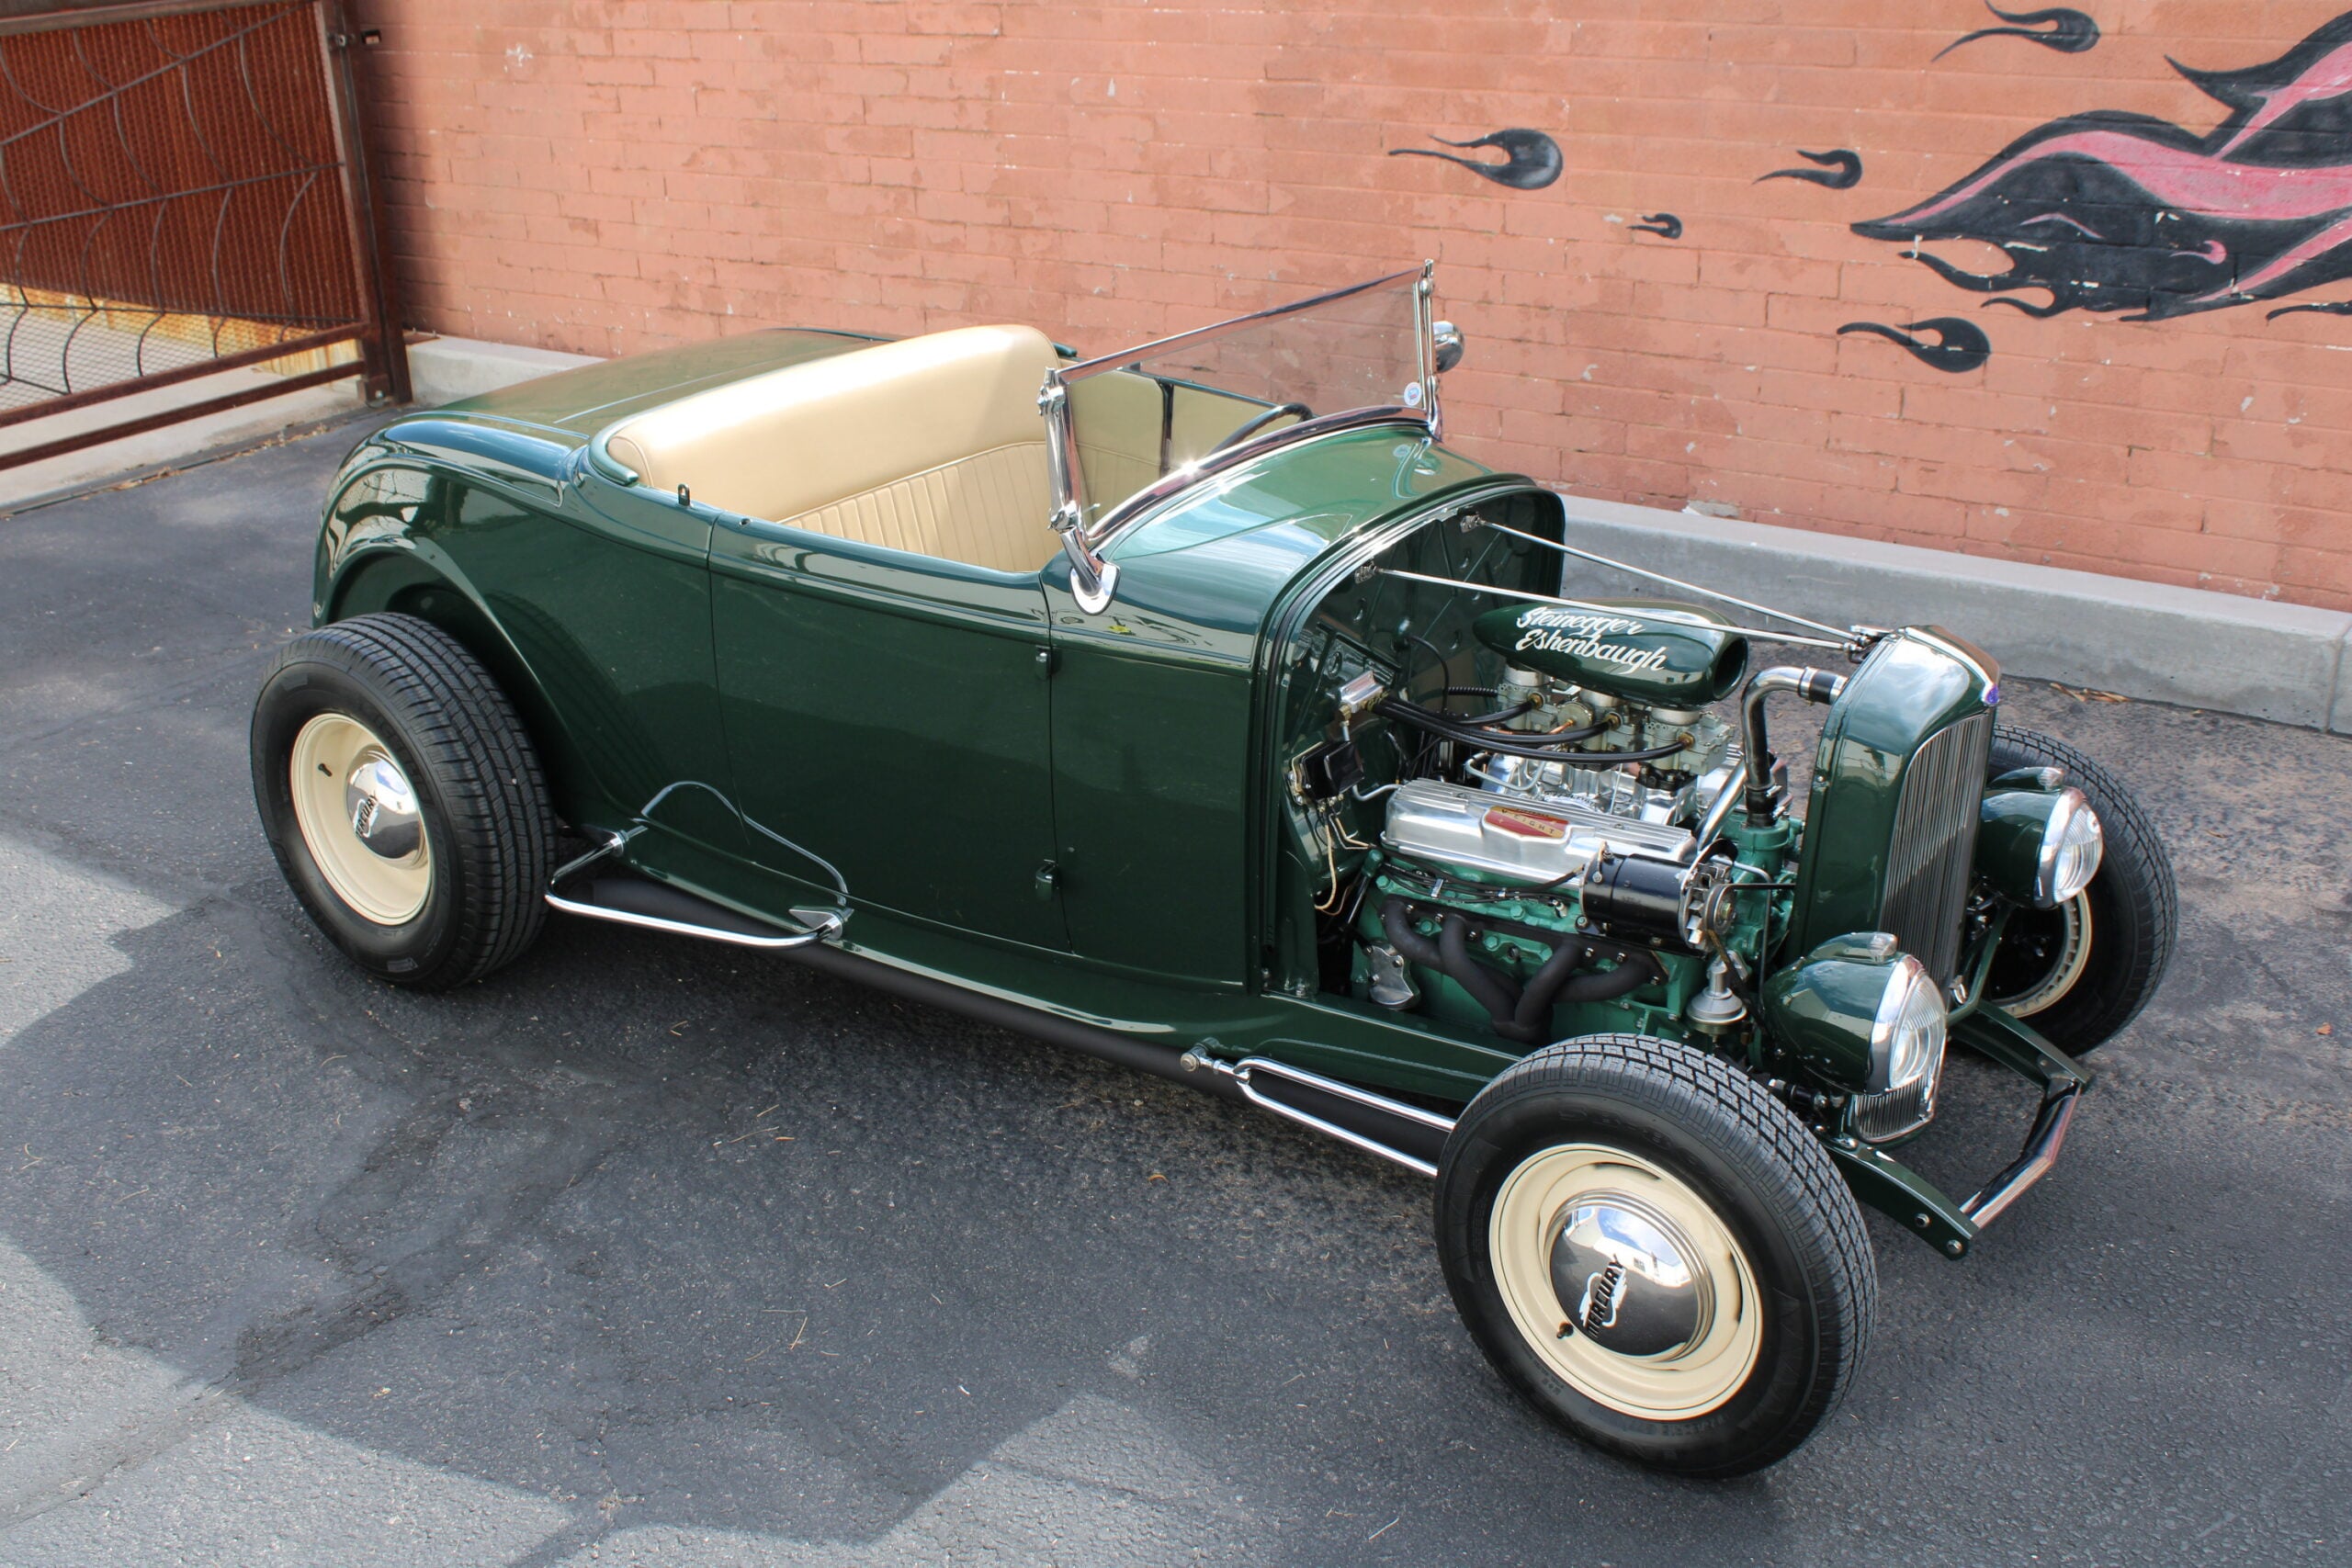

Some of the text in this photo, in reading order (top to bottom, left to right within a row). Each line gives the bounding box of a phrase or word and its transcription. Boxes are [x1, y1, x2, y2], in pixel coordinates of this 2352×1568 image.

[1516, 606, 1646, 637] Steinegger
[1515, 628, 1668, 675] Eshenbaugh
[1586, 1253, 1623, 1338] MERCURY
